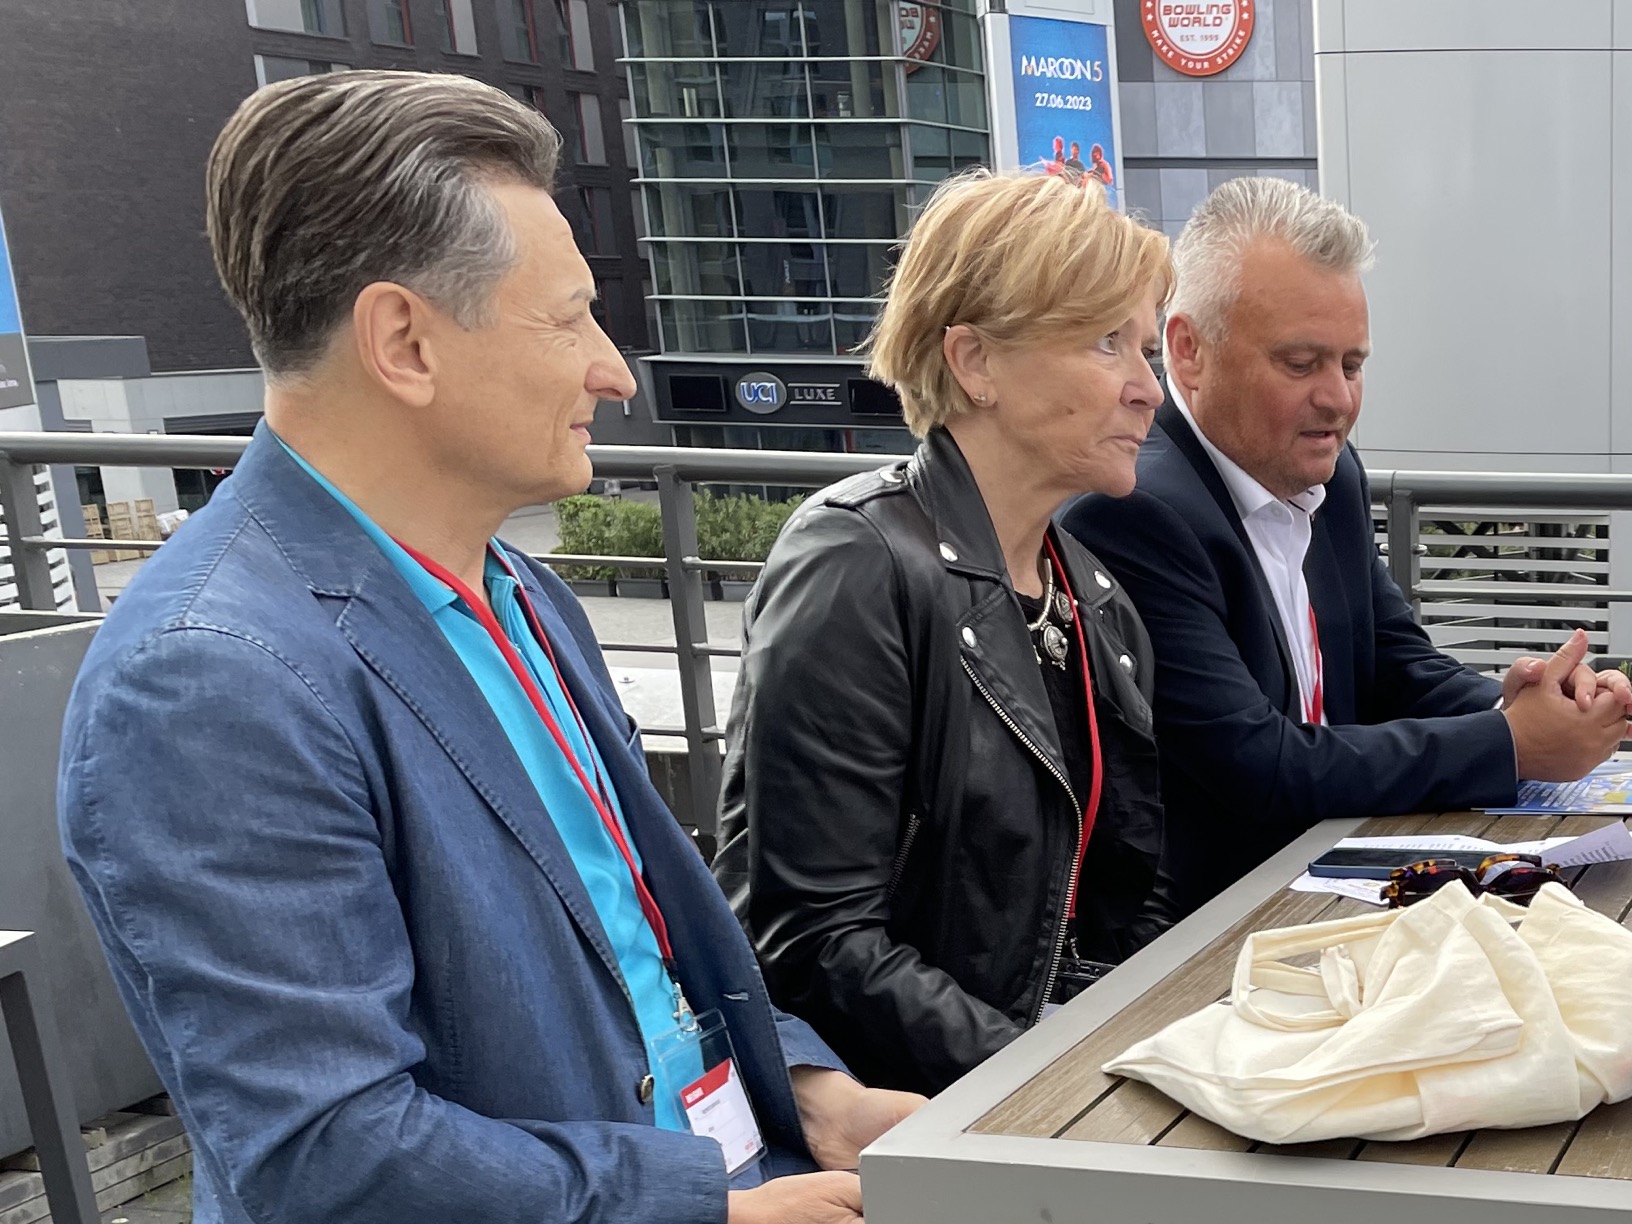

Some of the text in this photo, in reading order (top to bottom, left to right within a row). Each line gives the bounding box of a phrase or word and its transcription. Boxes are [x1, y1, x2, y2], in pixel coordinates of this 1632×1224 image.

[1163, 4, 1232, 15] BOWLING
[1168, 16, 1223, 28] WORLD
[1151, 29, 1246, 70] MAKE YOUR STRIKE
[1021, 54, 1102, 82] MAROON 5
[1035, 92, 1092, 111] 27.06.2023
[740, 382, 836, 405] UCI LUXE
